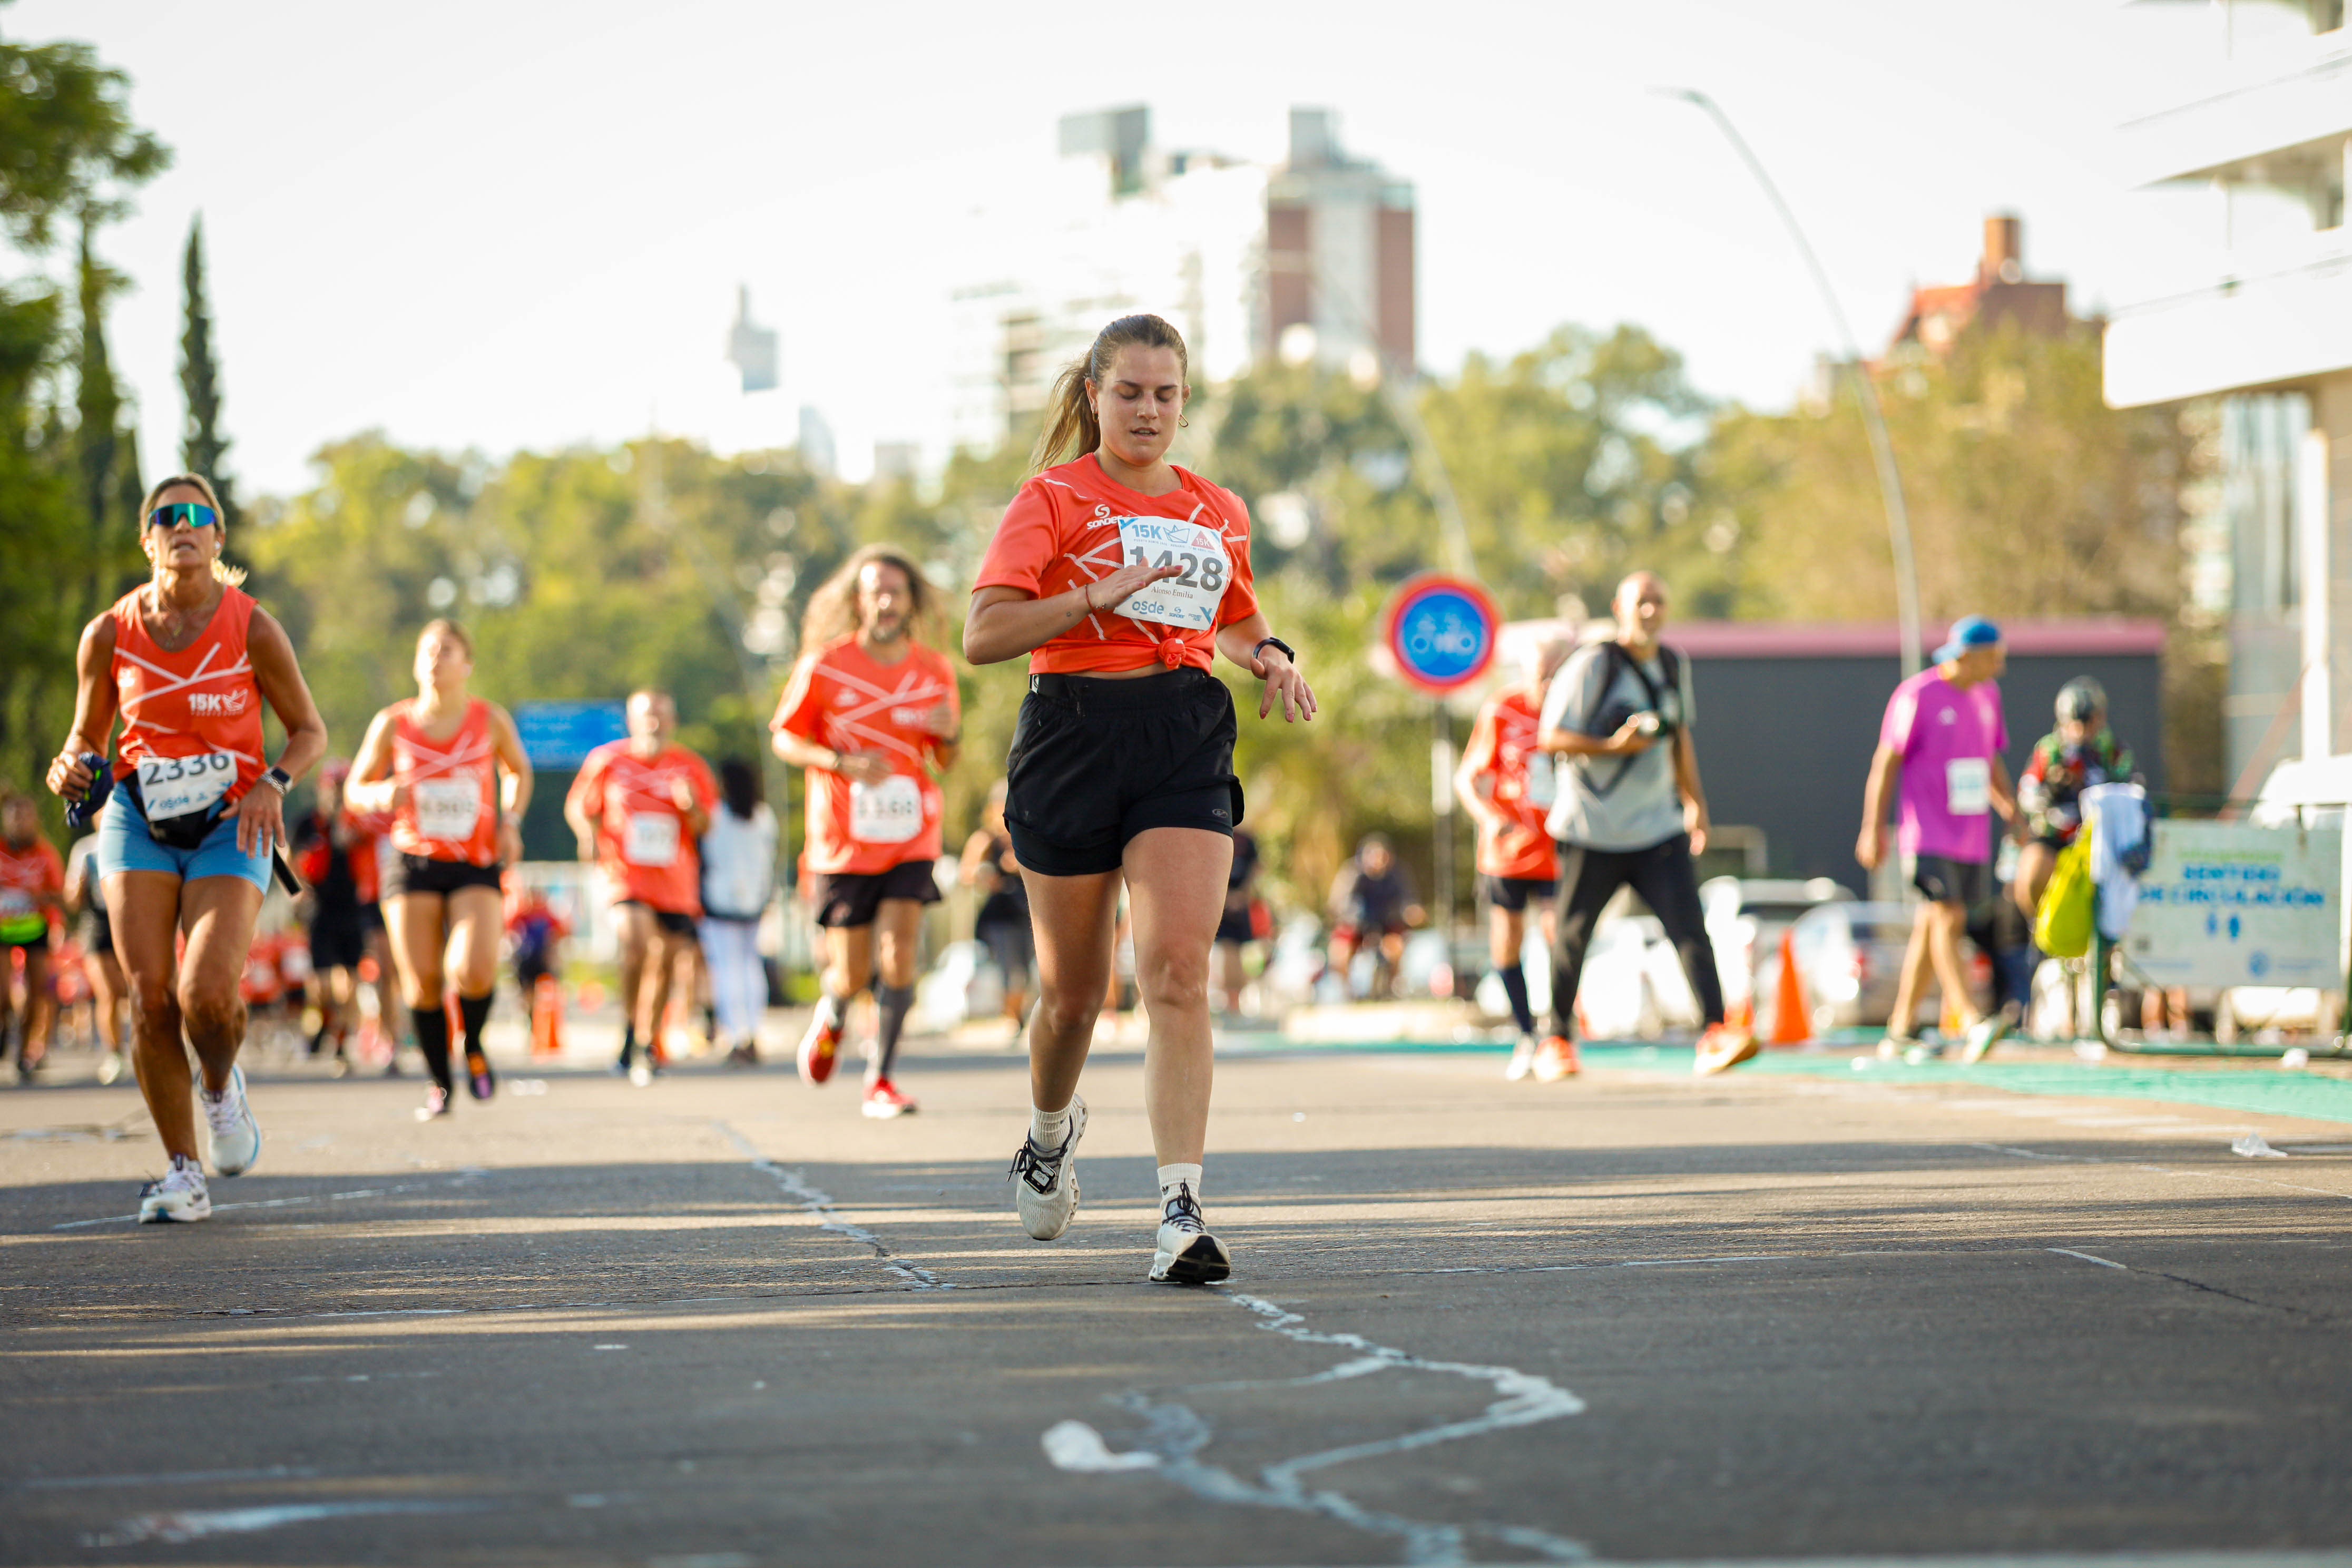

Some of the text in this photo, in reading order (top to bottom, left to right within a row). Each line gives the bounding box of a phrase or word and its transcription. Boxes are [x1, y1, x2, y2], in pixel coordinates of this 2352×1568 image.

[1132, 524, 1163, 540] 15K
[1195, 537, 1210, 547] 15K
[1130, 546, 1223, 592] 1428
[1151, 586, 1193, 599] Alonso Emilia
[1132, 601, 1164, 614] osde
[188, 693, 222, 712] 15K
[144, 754, 230, 786] 2336
